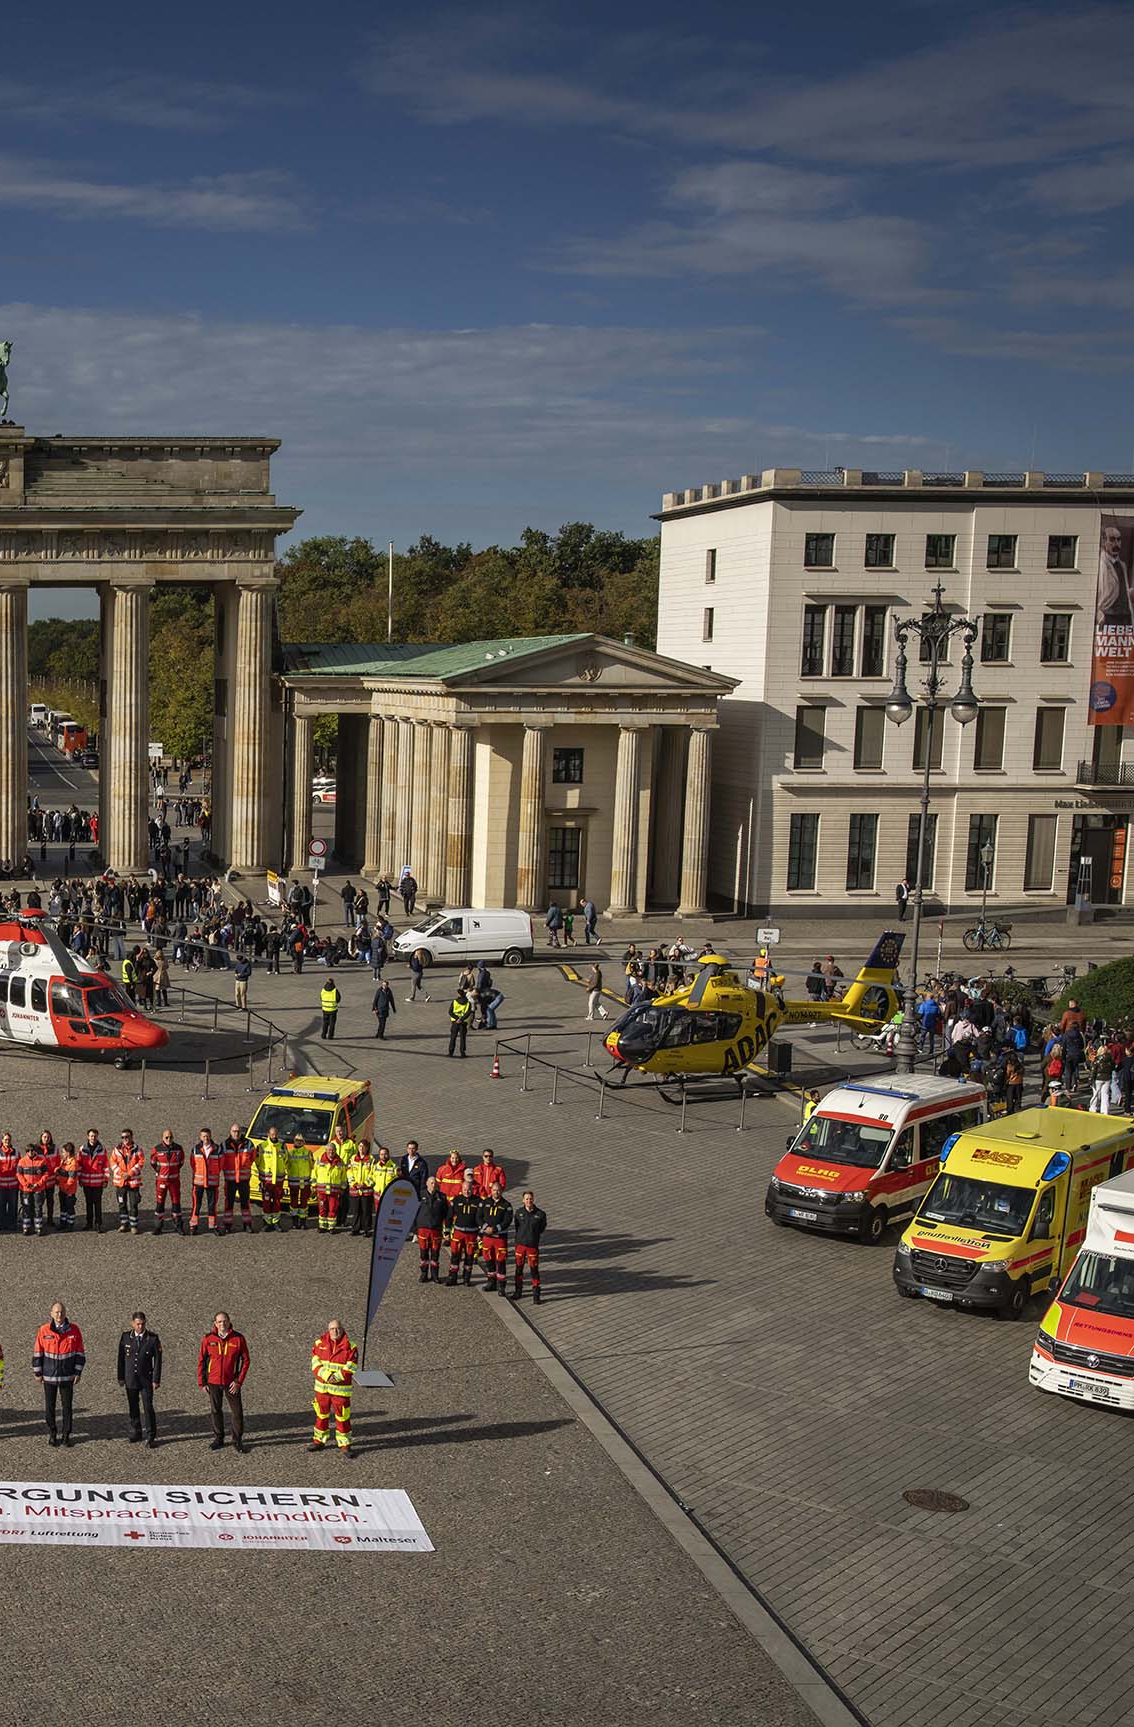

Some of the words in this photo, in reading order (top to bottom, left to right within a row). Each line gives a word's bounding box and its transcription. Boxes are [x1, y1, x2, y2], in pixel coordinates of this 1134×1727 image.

[1095, 647, 1132, 657] WELT
[724, 1012, 777, 1074] ADAC
[798, 1165, 841, 1178] DLRG
[165, 1491, 373, 1507] SICHERN.
[25, 1505, 189, 1520] Mitsprache
[200, 1510, 368, 1523] verbindlich.
[30, 1530, 99, 1538] Luftrettung
[356, 1536, 418, 1544] Malteser
